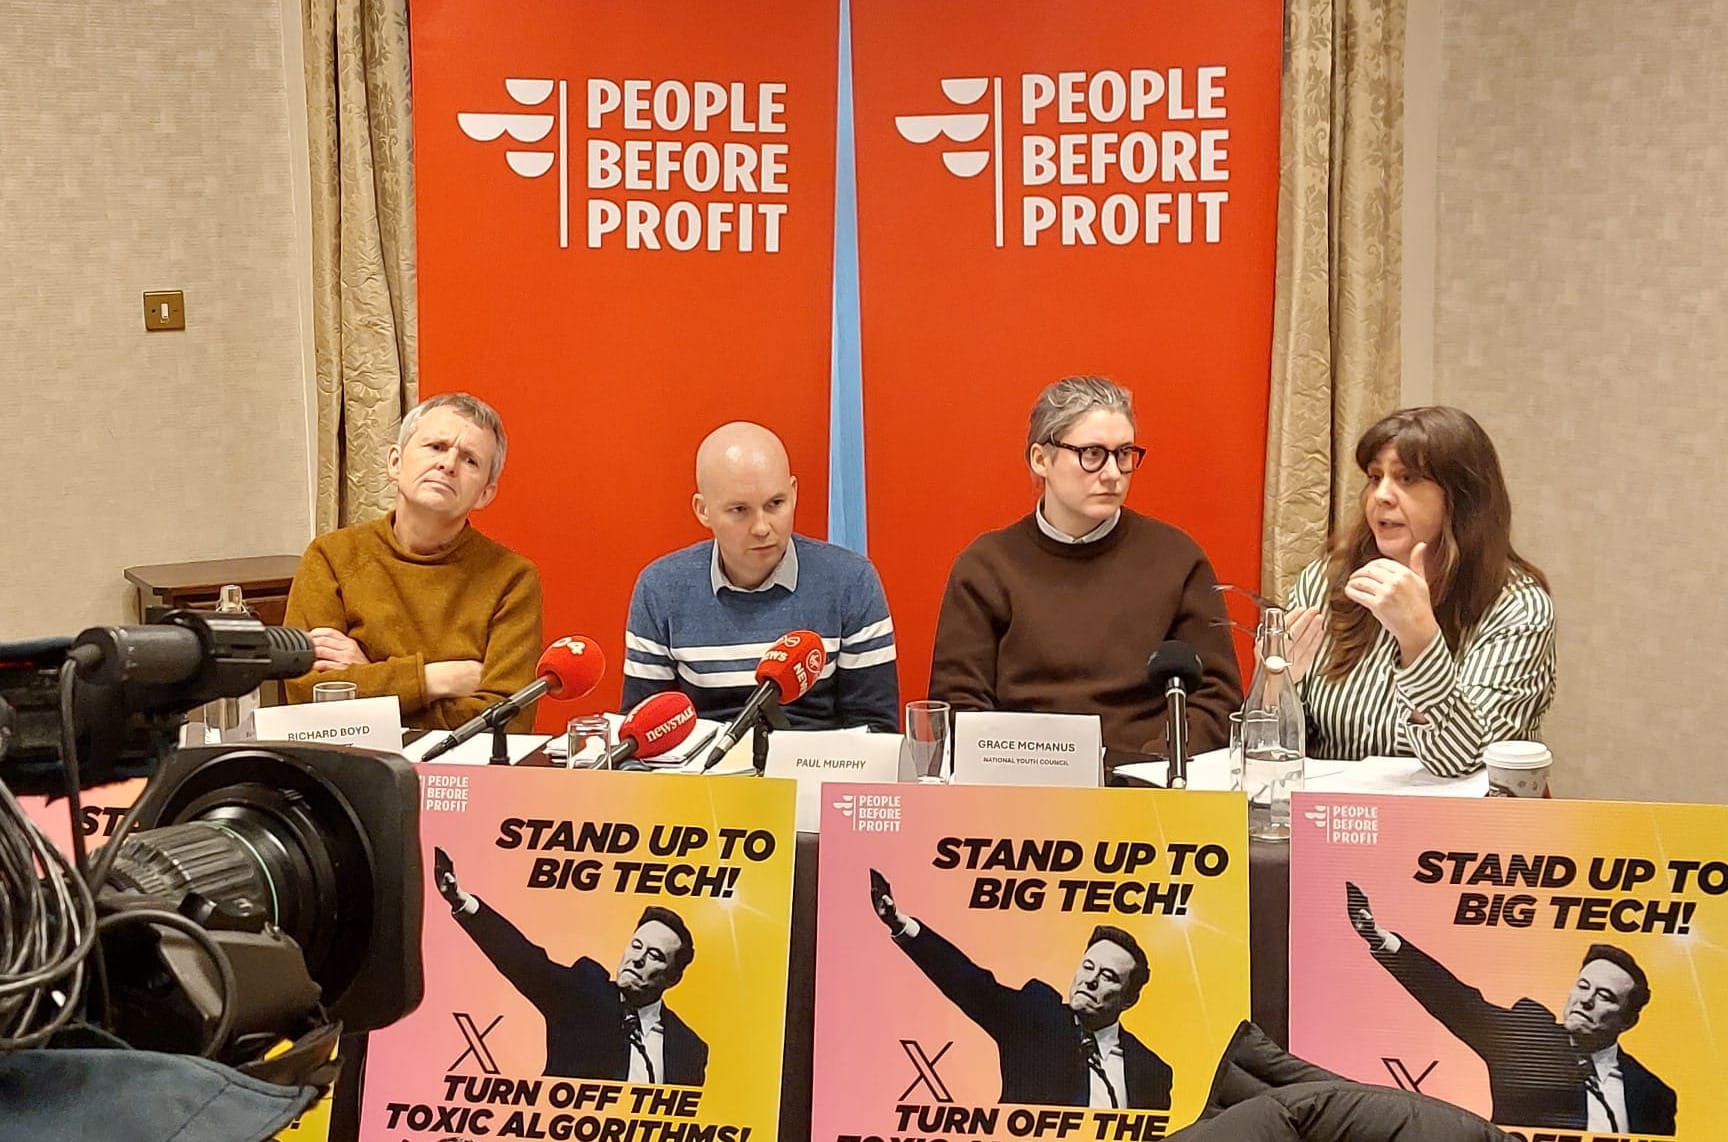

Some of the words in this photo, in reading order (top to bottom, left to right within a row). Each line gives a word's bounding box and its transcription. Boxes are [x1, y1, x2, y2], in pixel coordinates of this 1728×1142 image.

[587, 78, 787, 133] PEOPLE
[1021, 66, 1227, 125] PEOPLE
[587, 139, 789, 193] BEFORE
[1022, 129, 1230, 186] BEFORE
[587, 199, 788, 253] PROFIT
[1022, 191, 1229, 246] PROFIT
[288, 729, 338, 742] RICHARD
[340, 725, 370, 737] BOYD
[977, 739, 1015, 750] GRACE
[1017, 741, 1076, 752] MCMANUS
[428, 775, 469, 788] PEOPLE
[796, 758, 821, 768] PAUL
[823, 760, 866, 769] MURPHY
[426, 799, 468, 812] PROFIT
[427, 787, 469, 800] BEFORE
[859, 795, 901, 807] PEOPLE
[1333, 805, 1378, 818] PEOPLE
[858, 820, 901, 832] PROFIT
[859, 807, 901, 820] BEFORE
[1333, 819, 1379, 831] BEFORE
[495, 817, 640, 854] STAND
[648, 825, 709, 858] UP
[718, 828, 777, 862] TO
[932, 837, 1084, 872] STAND
[1093, 841, 1157, 874] UP
[1166, 843, 1230, 877] TO
[1332, 831, 1379, 845] PROFIT
[526, 858, 603, 892] BIG
[612, 862, 742, 898] TECH!
[1413, 850, 1577, 888] STAND
[1586, 857, 1656, 892] UP
[1667, 860, 1728, 896] TO
[968, 877, 1047, 911] BIG
[1057, 879, 1194, 916] TECH!
[1453, 892, 1538, 928] BIG
[1549, 896, 1697, 935] TECH!
[443, 1075, 546, 1107] TURN
[548, 1081, 622, 1111] OFF
[629, 1086, 704, 1117] THE
[386, 1103, 495, 1136] TOXIC
[895, 1104, 1000, 1135] TURN
[1006, 1108, 1085, 1138] OFF
[1093, 1112, 1170, 1142] THE
